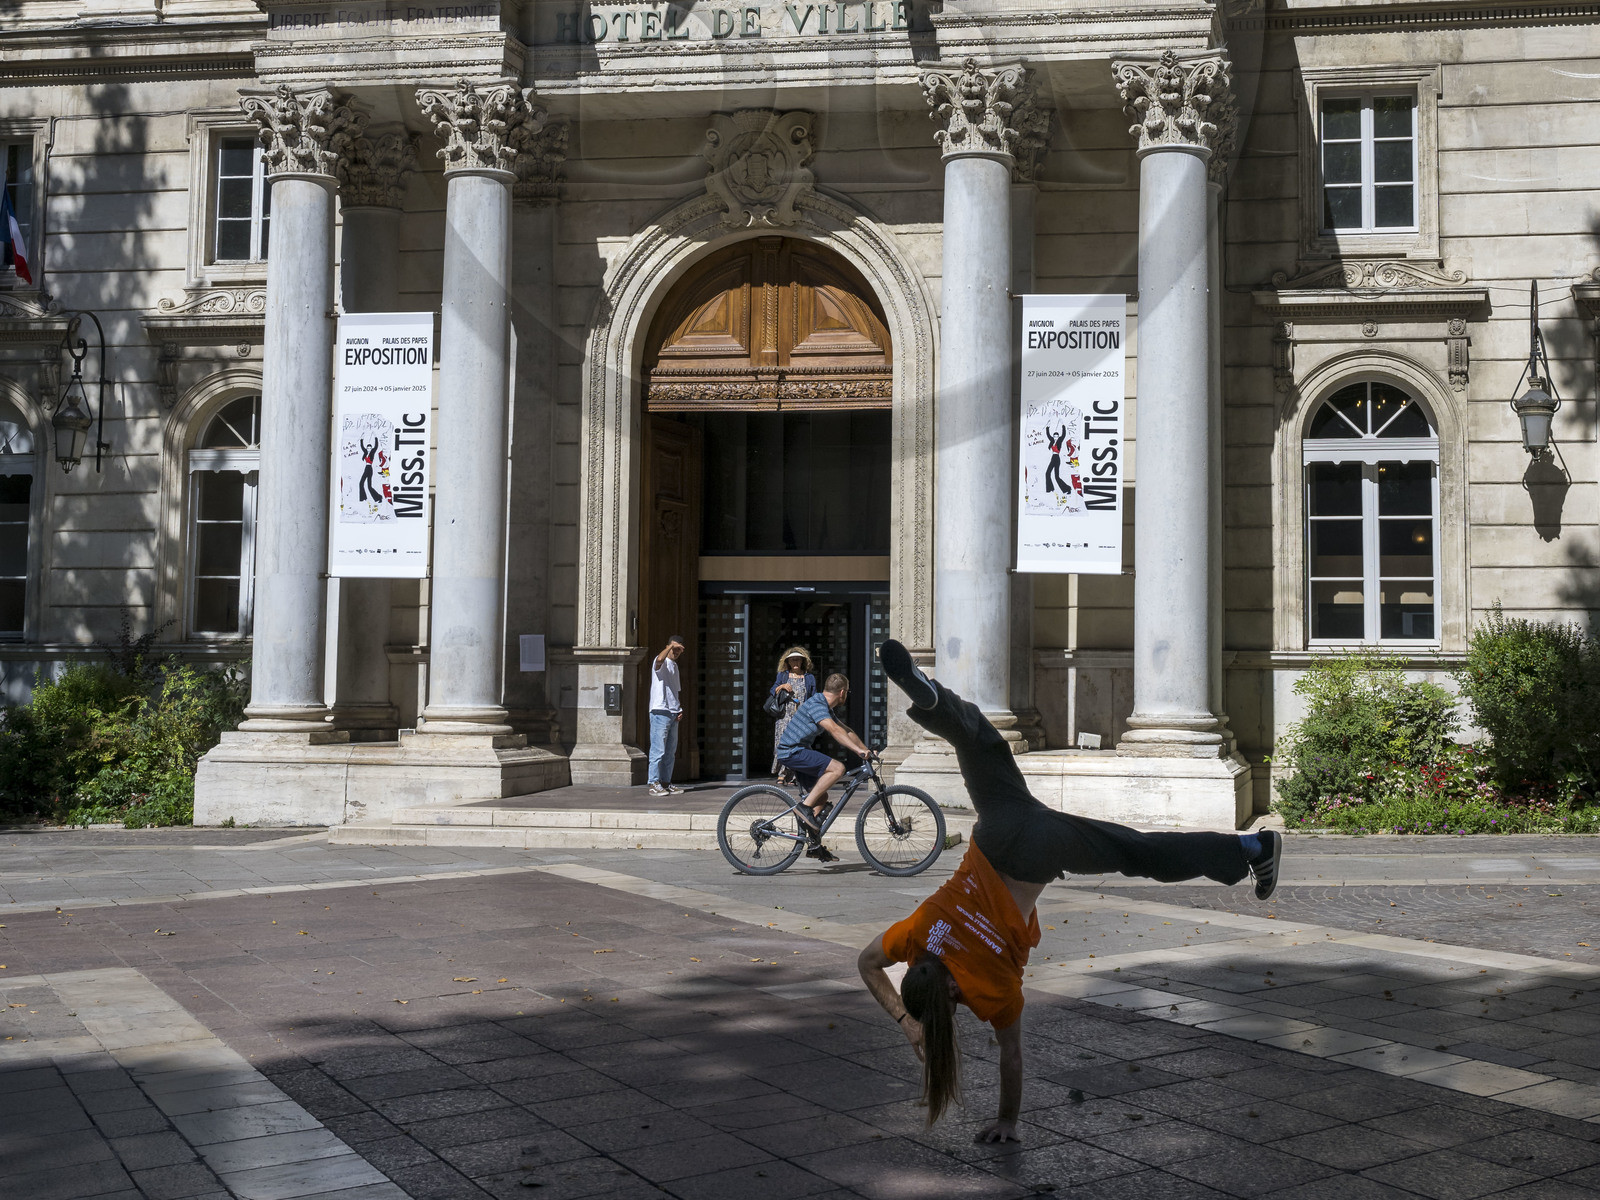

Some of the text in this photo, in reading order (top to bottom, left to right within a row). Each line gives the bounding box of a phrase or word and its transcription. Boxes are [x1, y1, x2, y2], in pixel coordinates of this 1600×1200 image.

[557, 0, 911, 42] HOTEL DE VILLE
[1028, 320, 1054, 328] AVIGNON
[1069, 320, 1120, 328] PALAIS DES PAPES
[1028, 331, 1120, 349] EXPOSITION
[345, 348, 428, 366] EXPOSITION
[1036, 370, 1047, 378] juin
[1081, 370, 1102, 378] janvier
[1082, 400, 1119, 511] Miss.Tic
[393, 413, 426, 518] Miss.Tic
